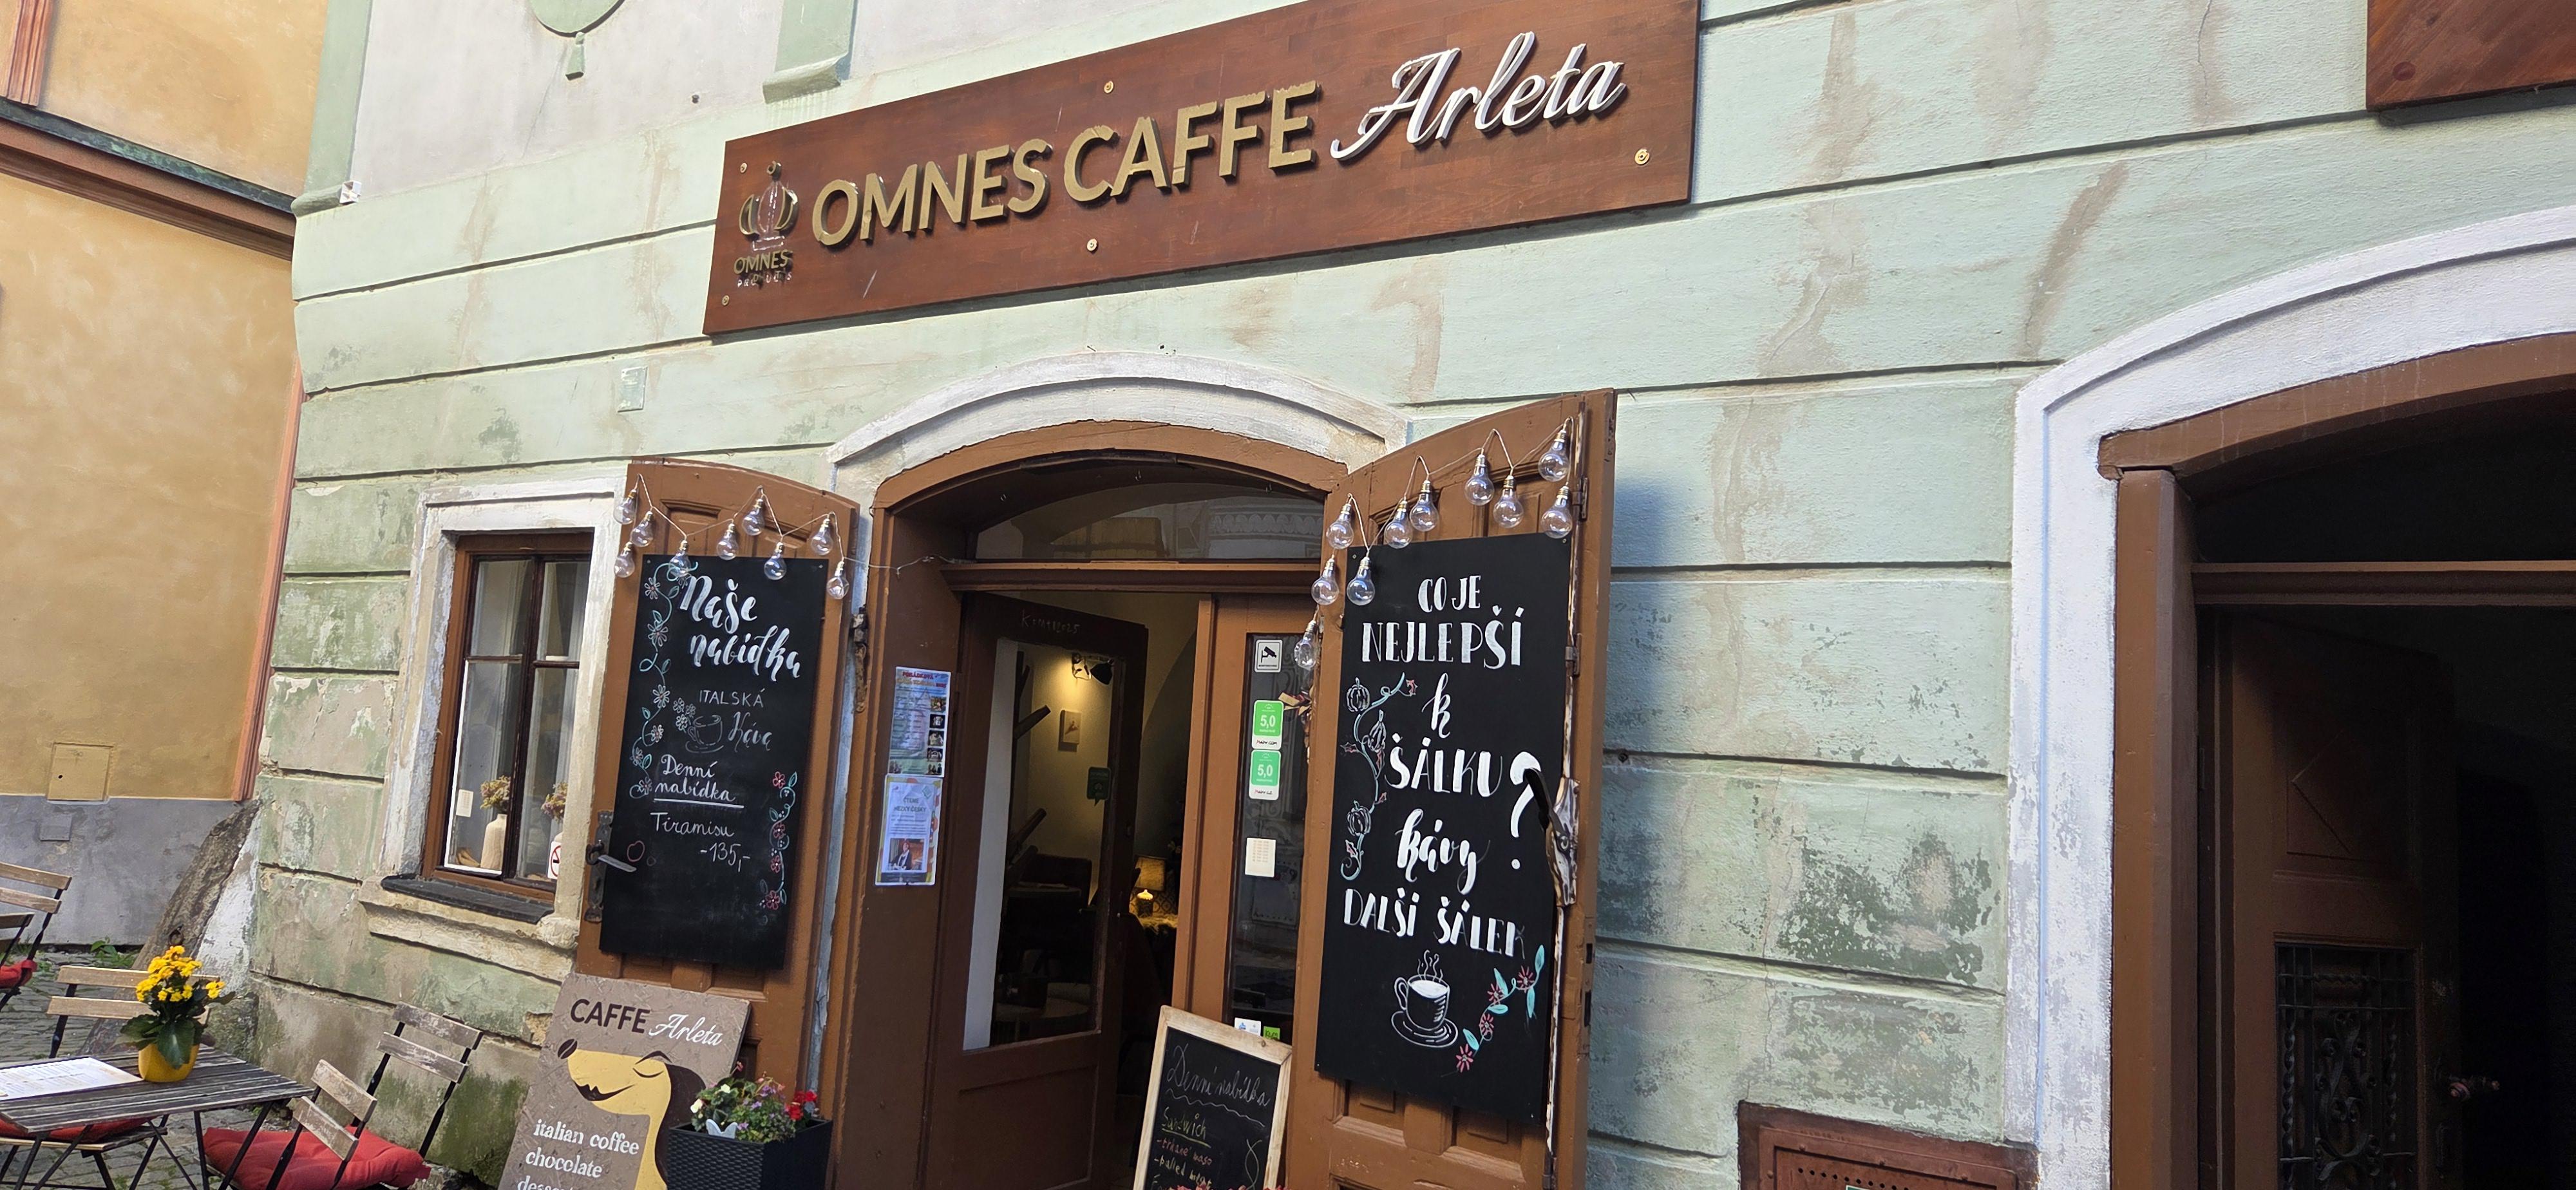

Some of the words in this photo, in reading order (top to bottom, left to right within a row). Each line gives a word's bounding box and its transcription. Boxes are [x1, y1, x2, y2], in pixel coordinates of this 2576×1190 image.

[812, 138, 1052, 246] OMNES
[1064, 80, 1324, 203] CAFFE
[1330, 30, 1627, 161] Arleta
[734, 249, 793, 275] OMNES
[680, 575, 757, 634] Naše
[1418, 576, 1447, 612] CO
[1452, 575, 1481, 610] JE
[690, 625, 800, 681] nabídka
[1361, 605, 1524, 669] NEJLEPŠÍ
[699, 688, 765, 708] ITALSKÁ
[1421, 672, 1451, 739] k
[728, 712, 773, 752] Káva
[1260, 715, 1276, 729] 5,0
[661, 754, 717, 778] Denní
[1258, 764, 1273, 778] 5,0
[1385, 733, 1503, 797] ŠÁLKU
[654, 777, 736, 802] nabídka
[650, 812, 734, 837] Tiramisu
[1395, 808, 1491, 895] kávy
[1344, 887, 1420, 938] DALŠÍ
[571, 999, 650, 1034] CAFFE
[649, 1014, 723, 1046] Arleta
[533, 1119, 584, 1145] italian
[589, 1131, 639, 1155] coffee
[1161, 1106, 1206, 1140] Sandwich
[526, 1147, 603, 1178] chocolate
